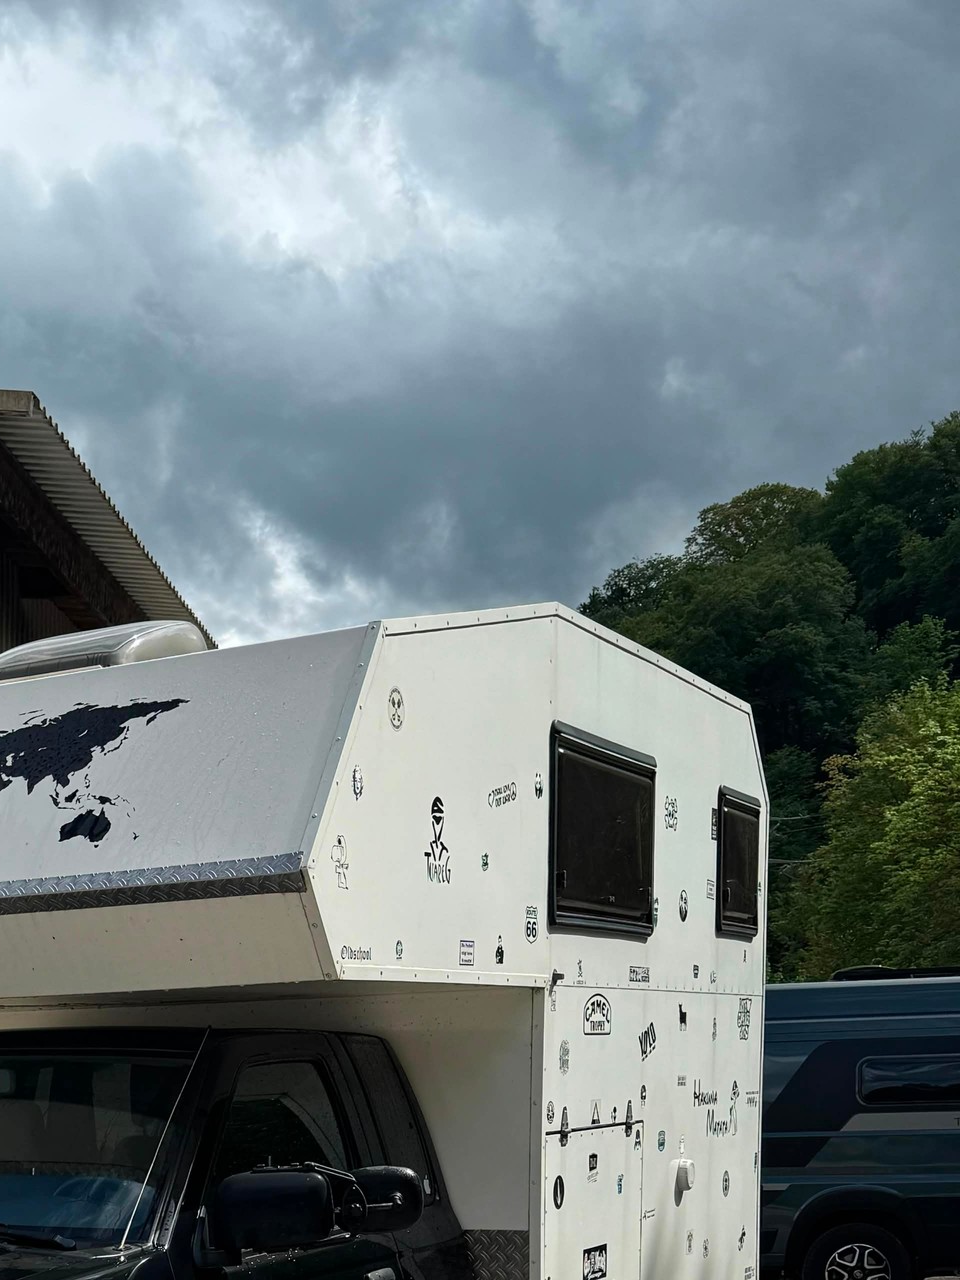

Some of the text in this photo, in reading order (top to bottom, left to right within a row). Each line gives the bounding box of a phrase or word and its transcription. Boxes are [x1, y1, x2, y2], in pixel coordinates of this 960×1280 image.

[526, 920, 537, 938] 66
[585, 999, 610, 1024] CAMEL
[638, 1021, 657, 1057] YOLO
